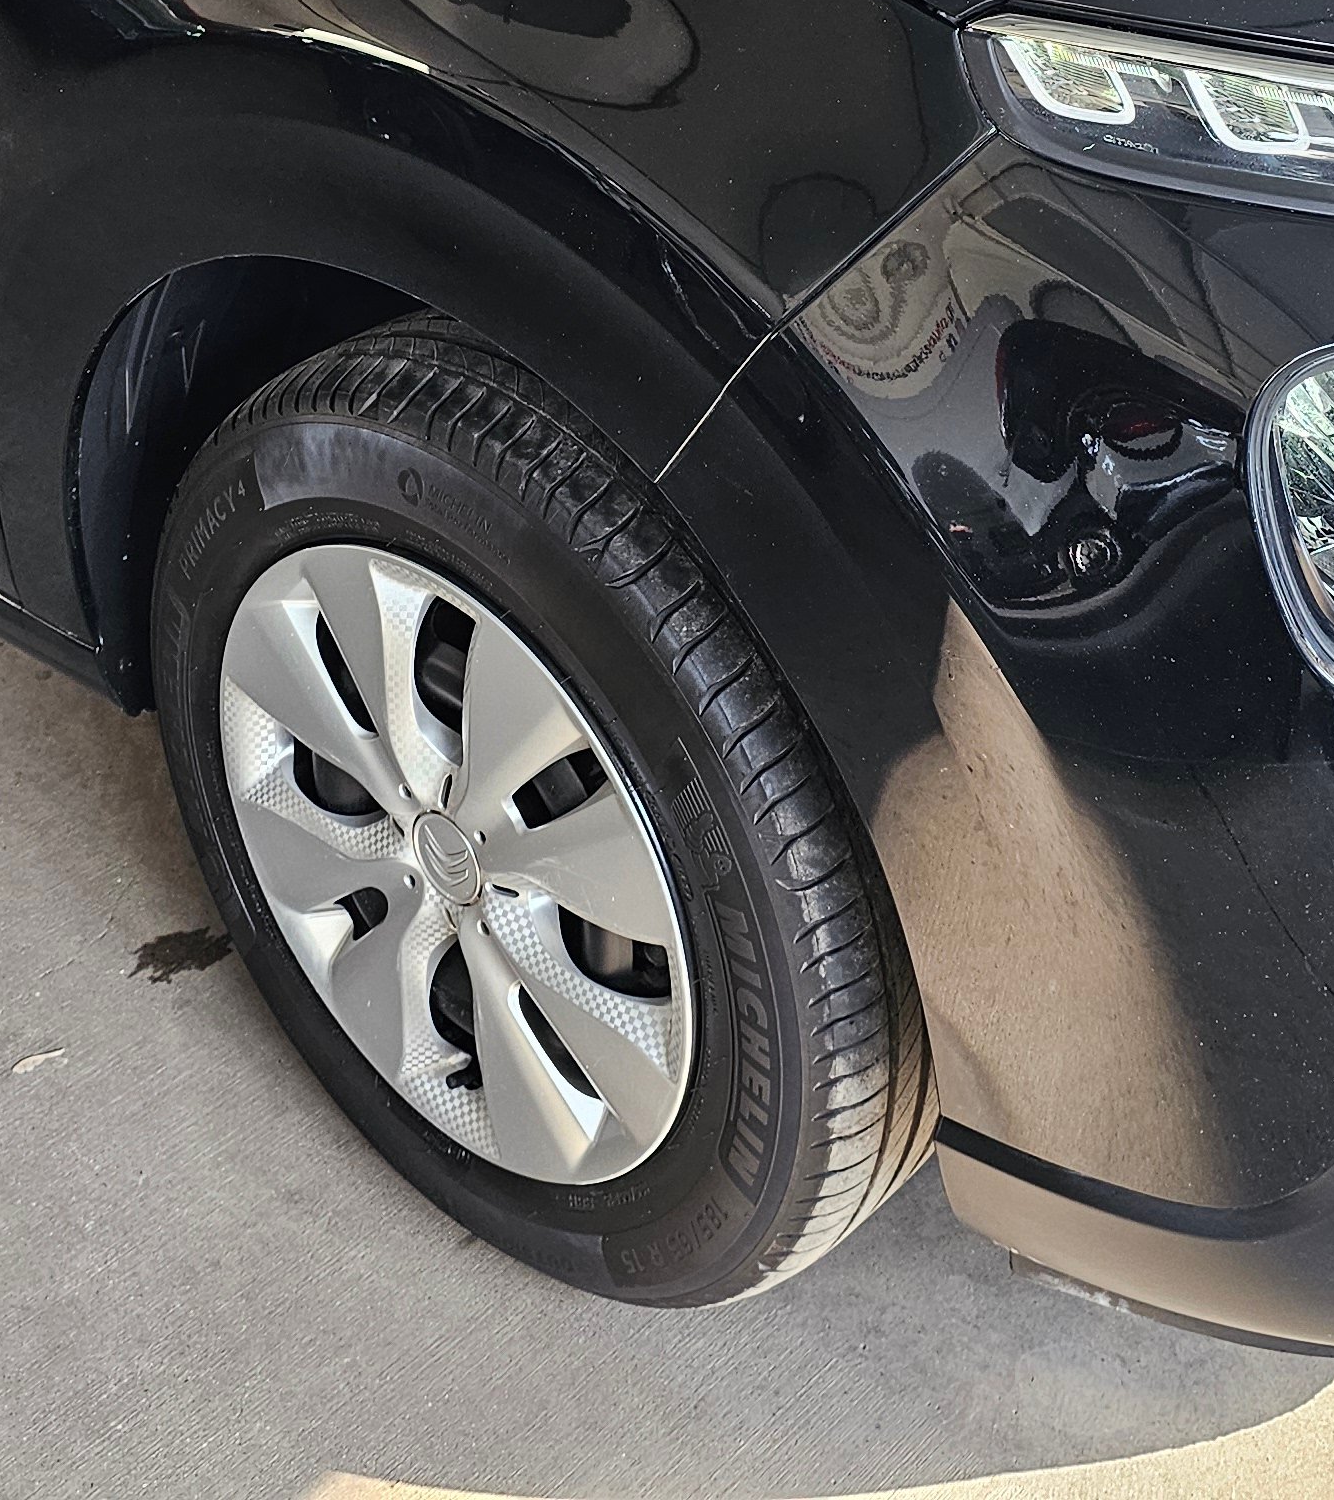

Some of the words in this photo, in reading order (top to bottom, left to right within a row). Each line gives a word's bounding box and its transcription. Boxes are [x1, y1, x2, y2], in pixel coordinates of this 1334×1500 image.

[178, 489, 238, 581] PRIMACY
[237, 479, 247, 497] 4
[717, 902, 771, 1188] MICHELIN
